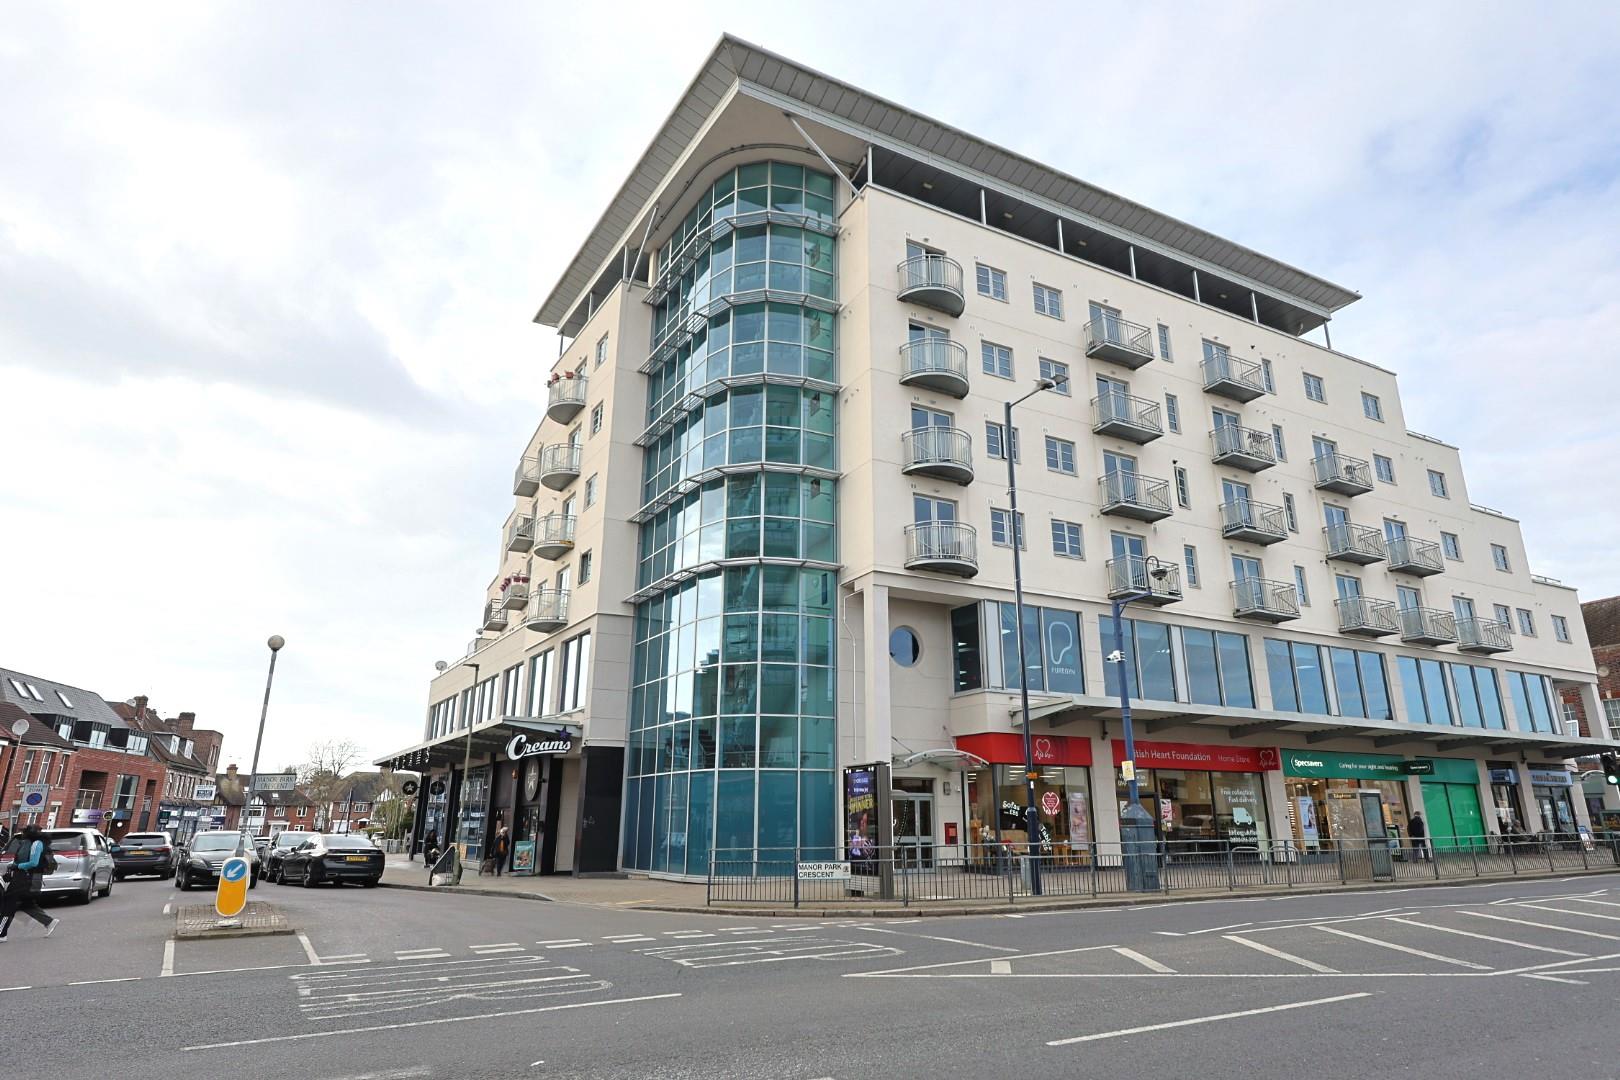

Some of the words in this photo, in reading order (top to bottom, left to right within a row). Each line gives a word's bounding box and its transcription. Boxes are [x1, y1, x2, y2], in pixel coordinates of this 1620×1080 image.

[508, 734, 571, 760] Creams
[1151, 750, 1171, 760] Heart
[1172, 751, 1211, 761] Foundation
[1294, 759, 1323, 768] Specsavers
[1003, 800, 1020, 811] Sofas
[799, 863, 823, 871] MANOR
